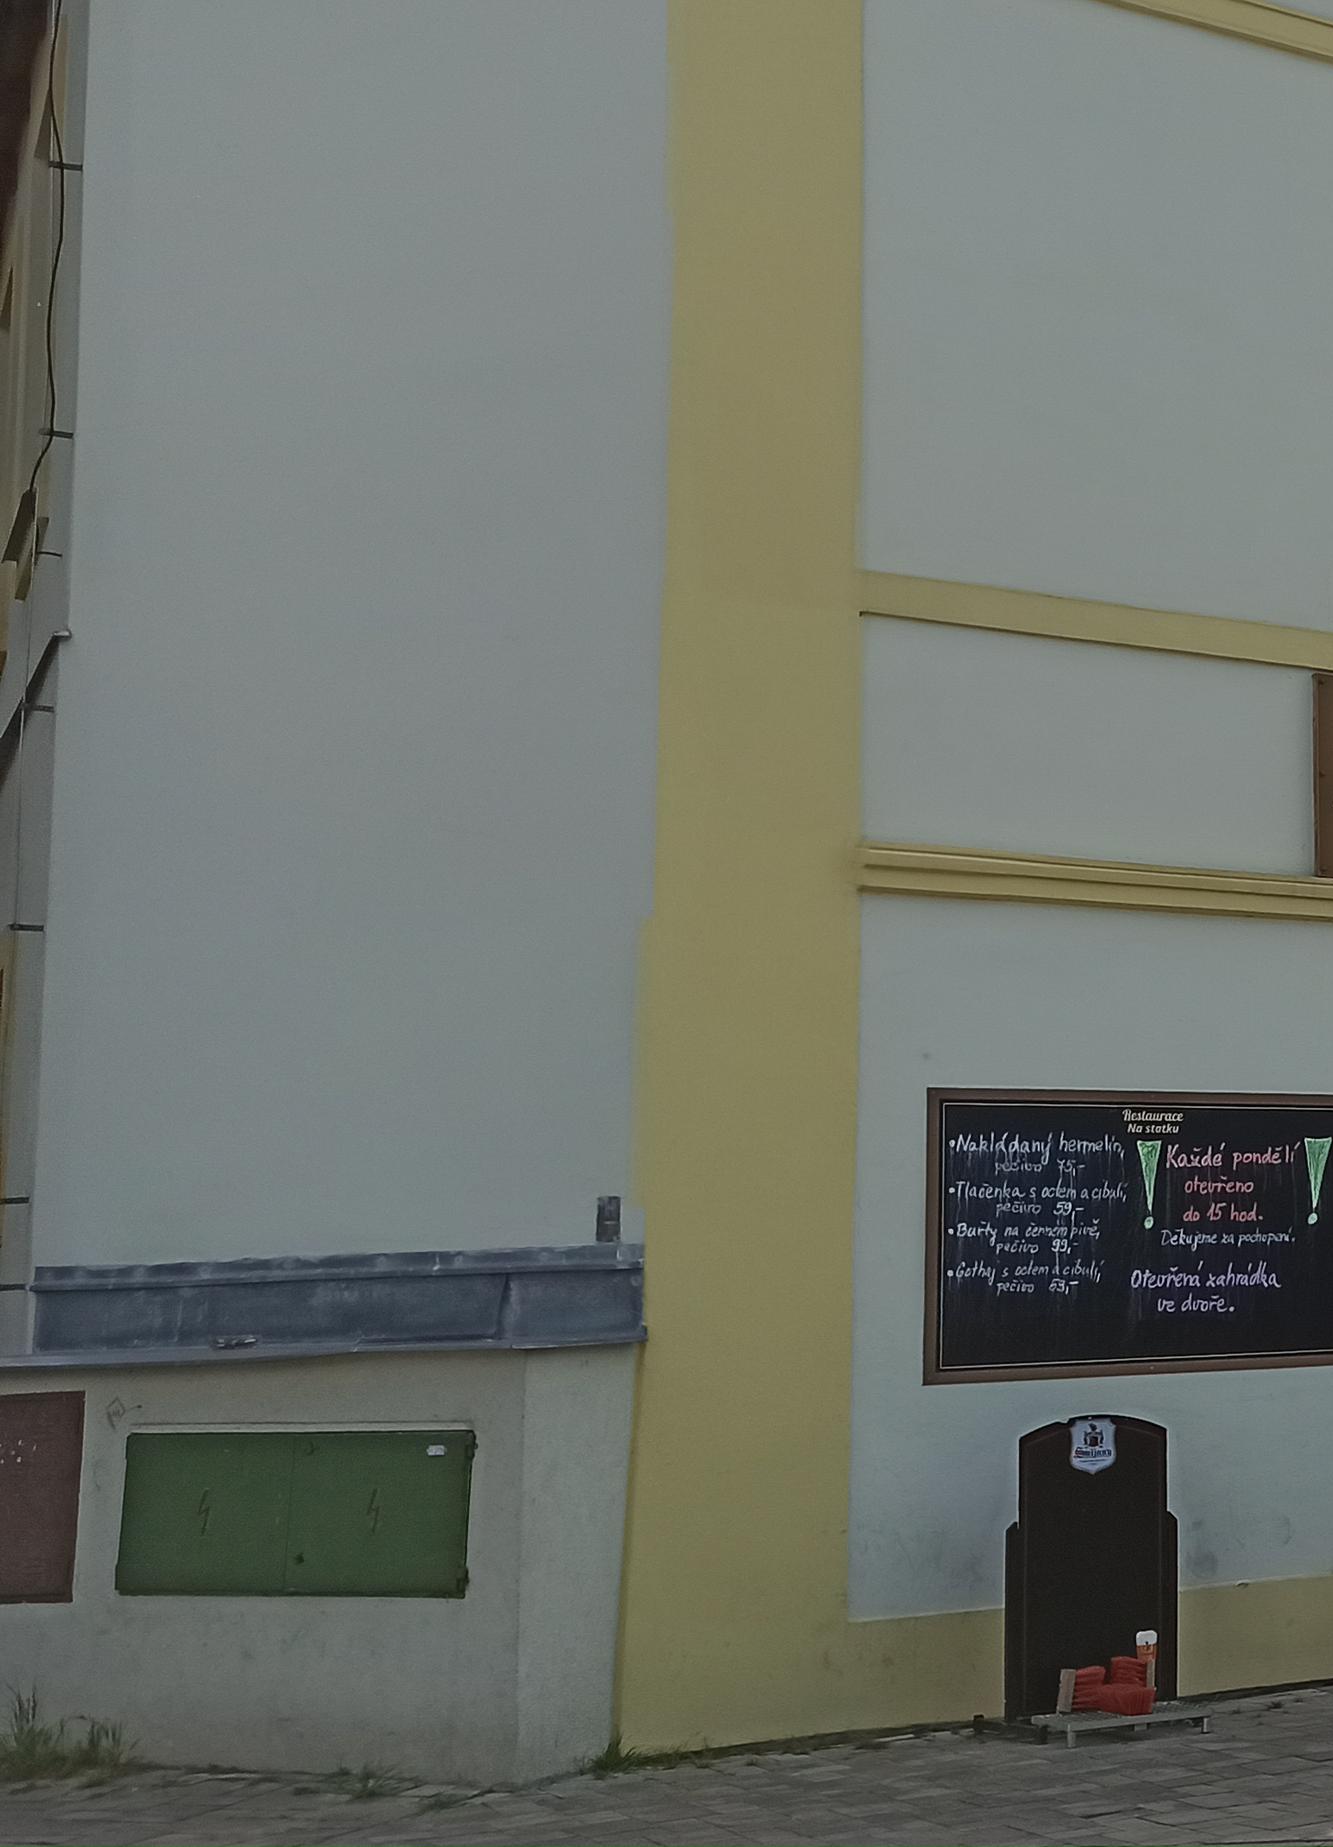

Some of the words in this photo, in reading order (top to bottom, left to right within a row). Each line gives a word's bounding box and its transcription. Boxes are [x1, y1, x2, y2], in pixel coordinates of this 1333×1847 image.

[1122, 1108, 1185, 1122] Restaurace
[1127, 1123, 1143, 1134] Na
[1145, 1123, 1180, 1134] statku
[1165, 1142, 1226, 1169] Každé
[1232, 1141, 1301, 1170] pondělí
[1029, 1186, 1037, 1199] s
[1080, 1189, 1090, 1199] a
[1184, 1175, 1255, 1194] otevřeno
[1183, 1203, 1201, 1222] do
[1206, 1202, 1225, 1221] 15
[1231, 1202, 1264, 1222] hod.
[1004, 1226, 1019, 1237] na
[1161, 1228, 1218, 1251] Děkujeme
[1221, 1233, 1235, 1244] za
[1130, 1260, 1205, 1288] Otevřená
[1205, 1260, 1283, 1288] zahrádka
[1157, 1296, 1177, 1313] ve
[1181, 1292, 1236, 1313] dvoře.
